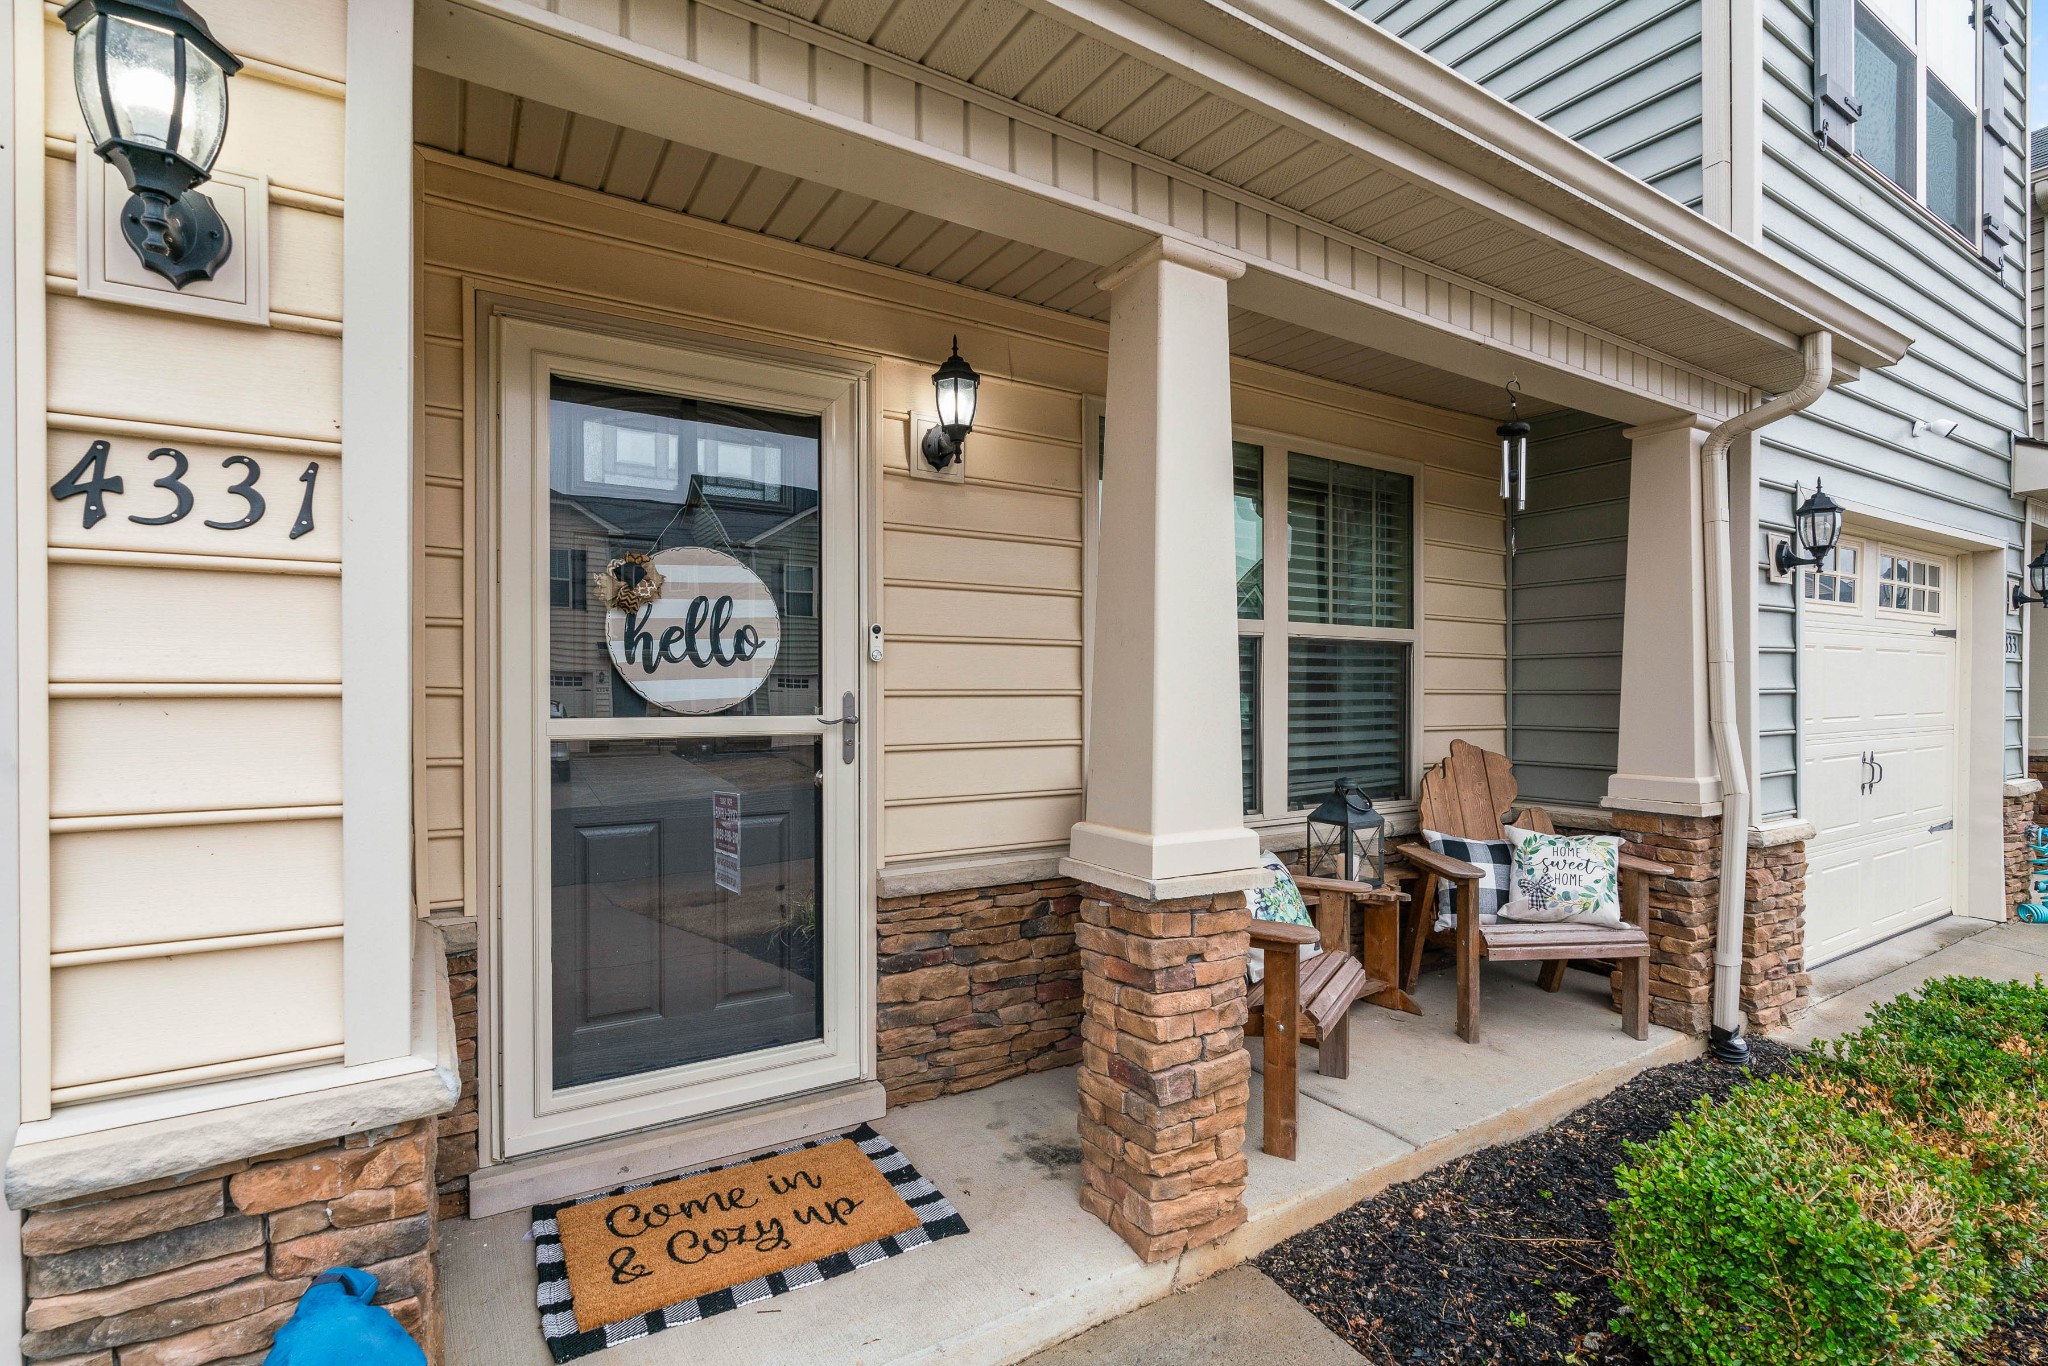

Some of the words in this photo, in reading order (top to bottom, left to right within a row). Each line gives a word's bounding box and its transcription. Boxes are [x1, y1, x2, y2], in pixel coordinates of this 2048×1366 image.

[51, 440, 319, 539] 4331
[624, 595, 766, 674] hello
[1552, 846, 1581, 858] HOME
[1554, 873, 1583, 887] HOME
[606, 1187, 758, 1238] Come
[767, 1171, 822, 1195] in
[608, 1246, 654, 1284] &
[666, 1217, 791, 1264] Cozy
[793, 1197, 864, 1225] up
